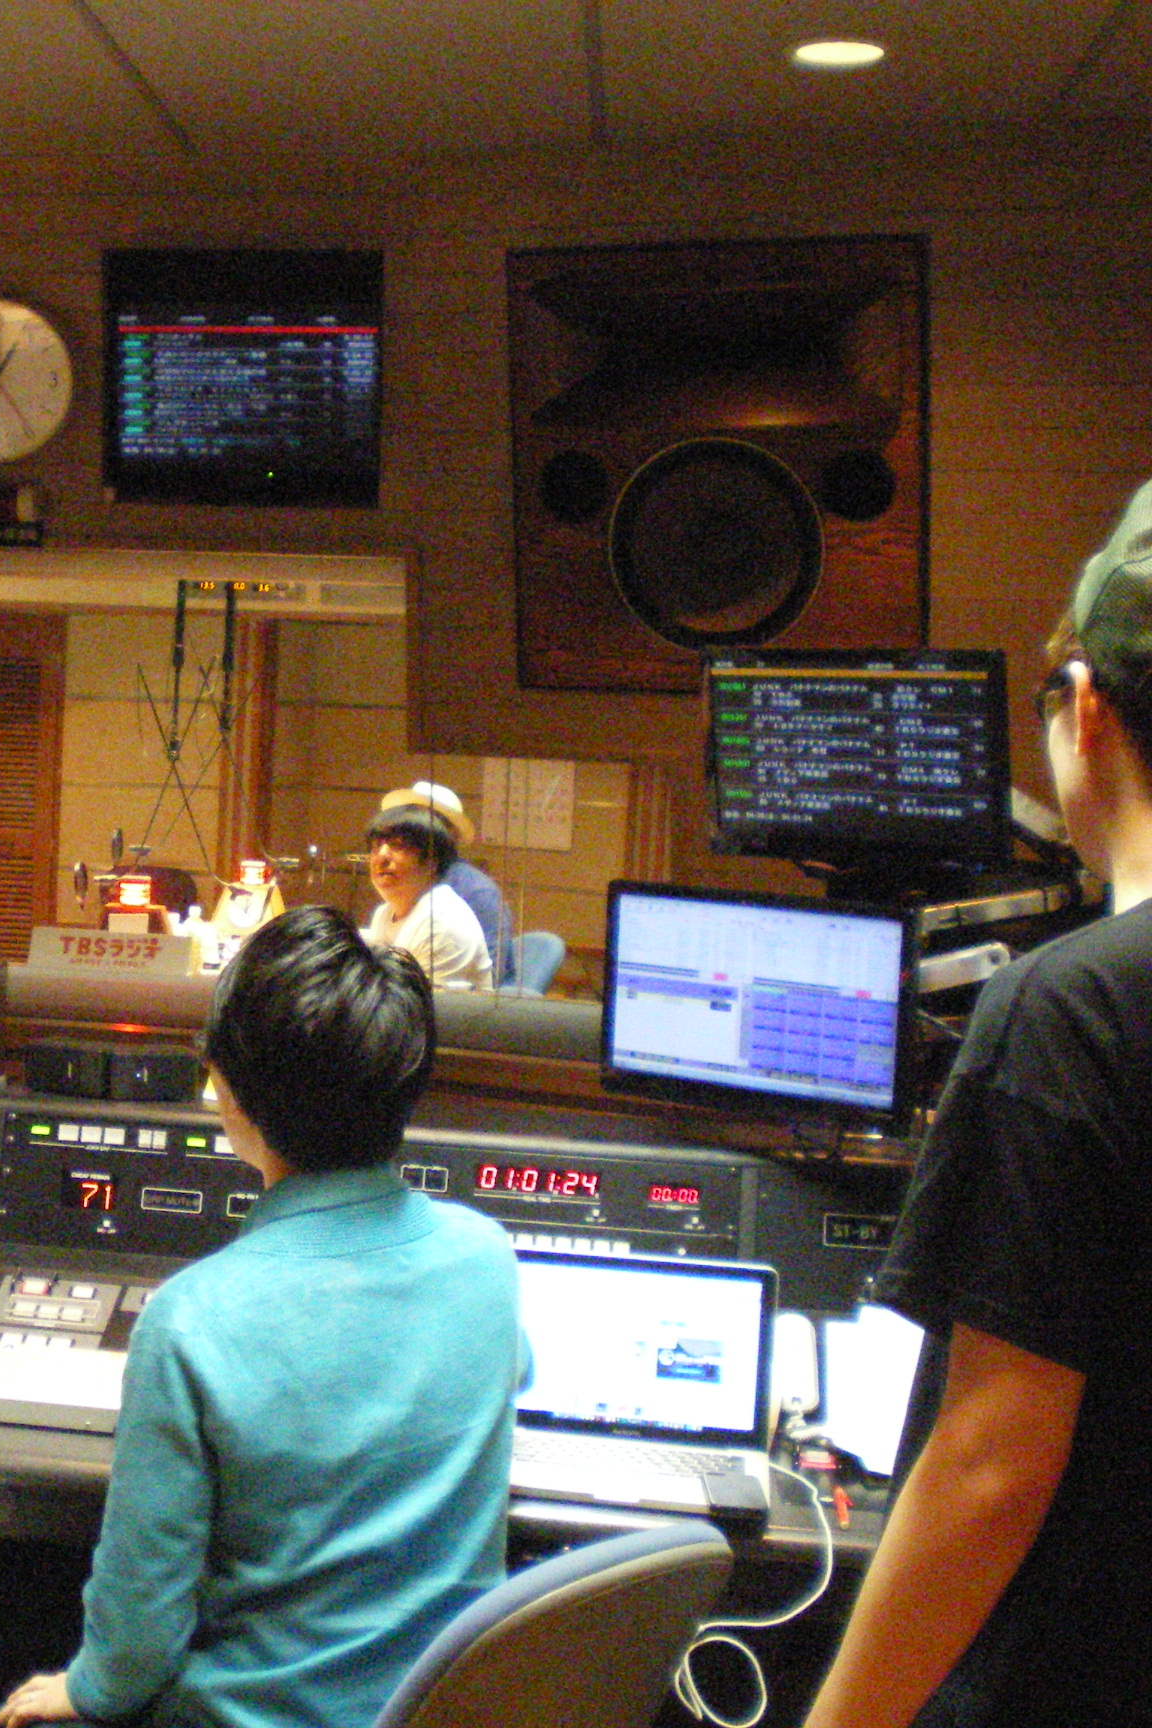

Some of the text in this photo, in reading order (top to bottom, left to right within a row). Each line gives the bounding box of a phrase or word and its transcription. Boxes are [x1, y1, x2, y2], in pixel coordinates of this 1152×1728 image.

[60, 935, 162, 960] TBSラジオ
[479, 1166, 598, 1195] 01:01:24
[81, 1182, 112, 1210] 71
[651, 1187, 699, 1204] 00:00
